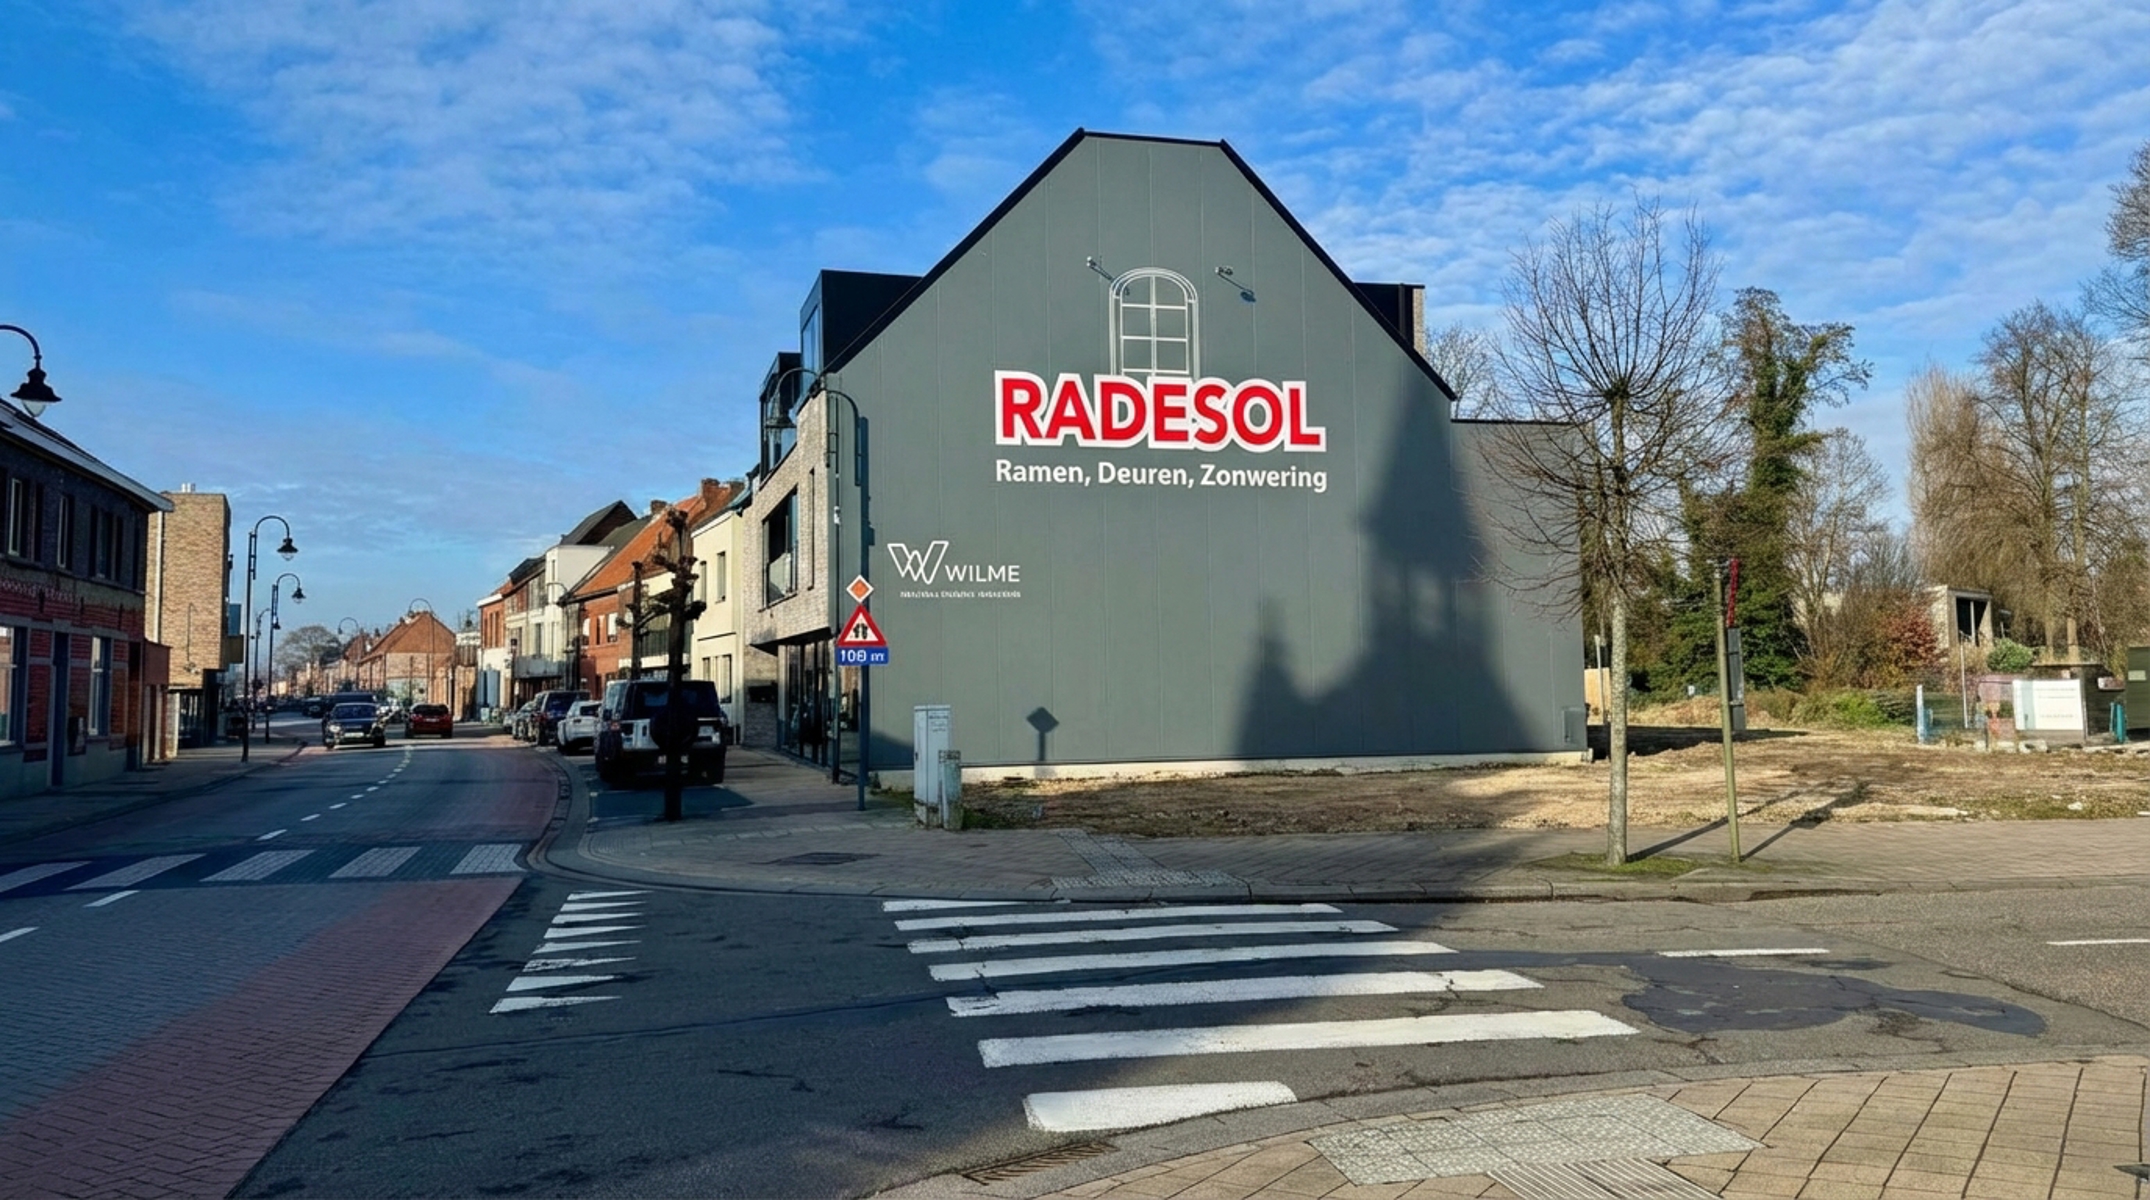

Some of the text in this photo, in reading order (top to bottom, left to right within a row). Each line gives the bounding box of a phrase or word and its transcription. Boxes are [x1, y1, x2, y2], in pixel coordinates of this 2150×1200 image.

[995, 371, 1326, 452] RADESOL
[996, 459, 1328, 493] Ramen, Deuren, Zonwering
[945, 564, 1021, 582] WILME
[871, 652, 885, 662] m
